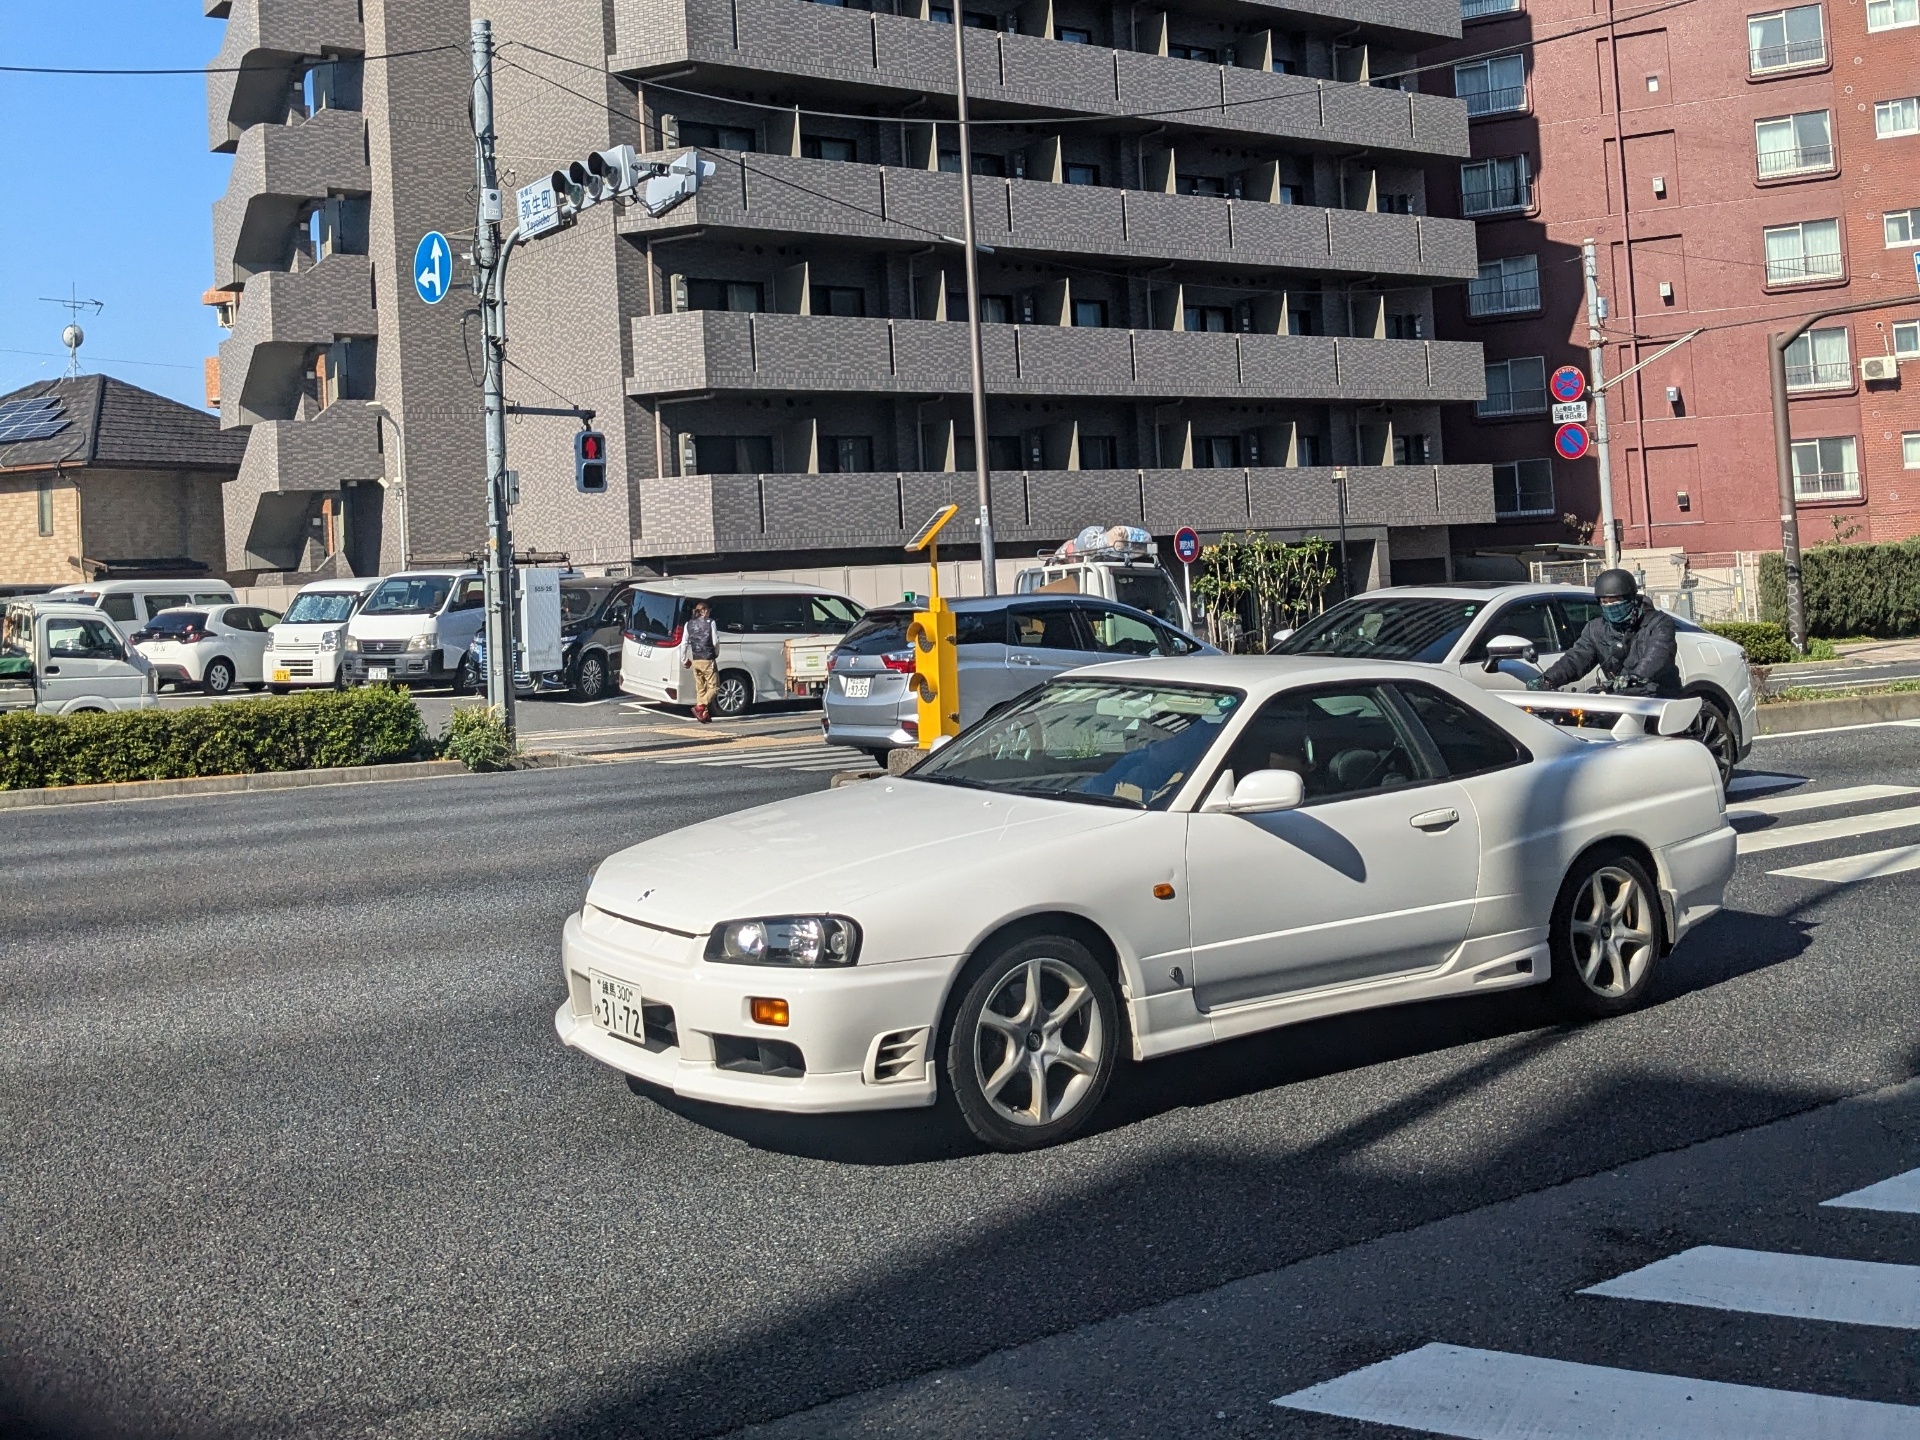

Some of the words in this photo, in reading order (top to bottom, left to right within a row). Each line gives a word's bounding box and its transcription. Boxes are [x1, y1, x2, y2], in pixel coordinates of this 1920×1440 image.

[521, 189, 551, 220] 弥生町
[850, 685, 868, 695] 93-55
[602, 998, 642, 1038] 31-72
